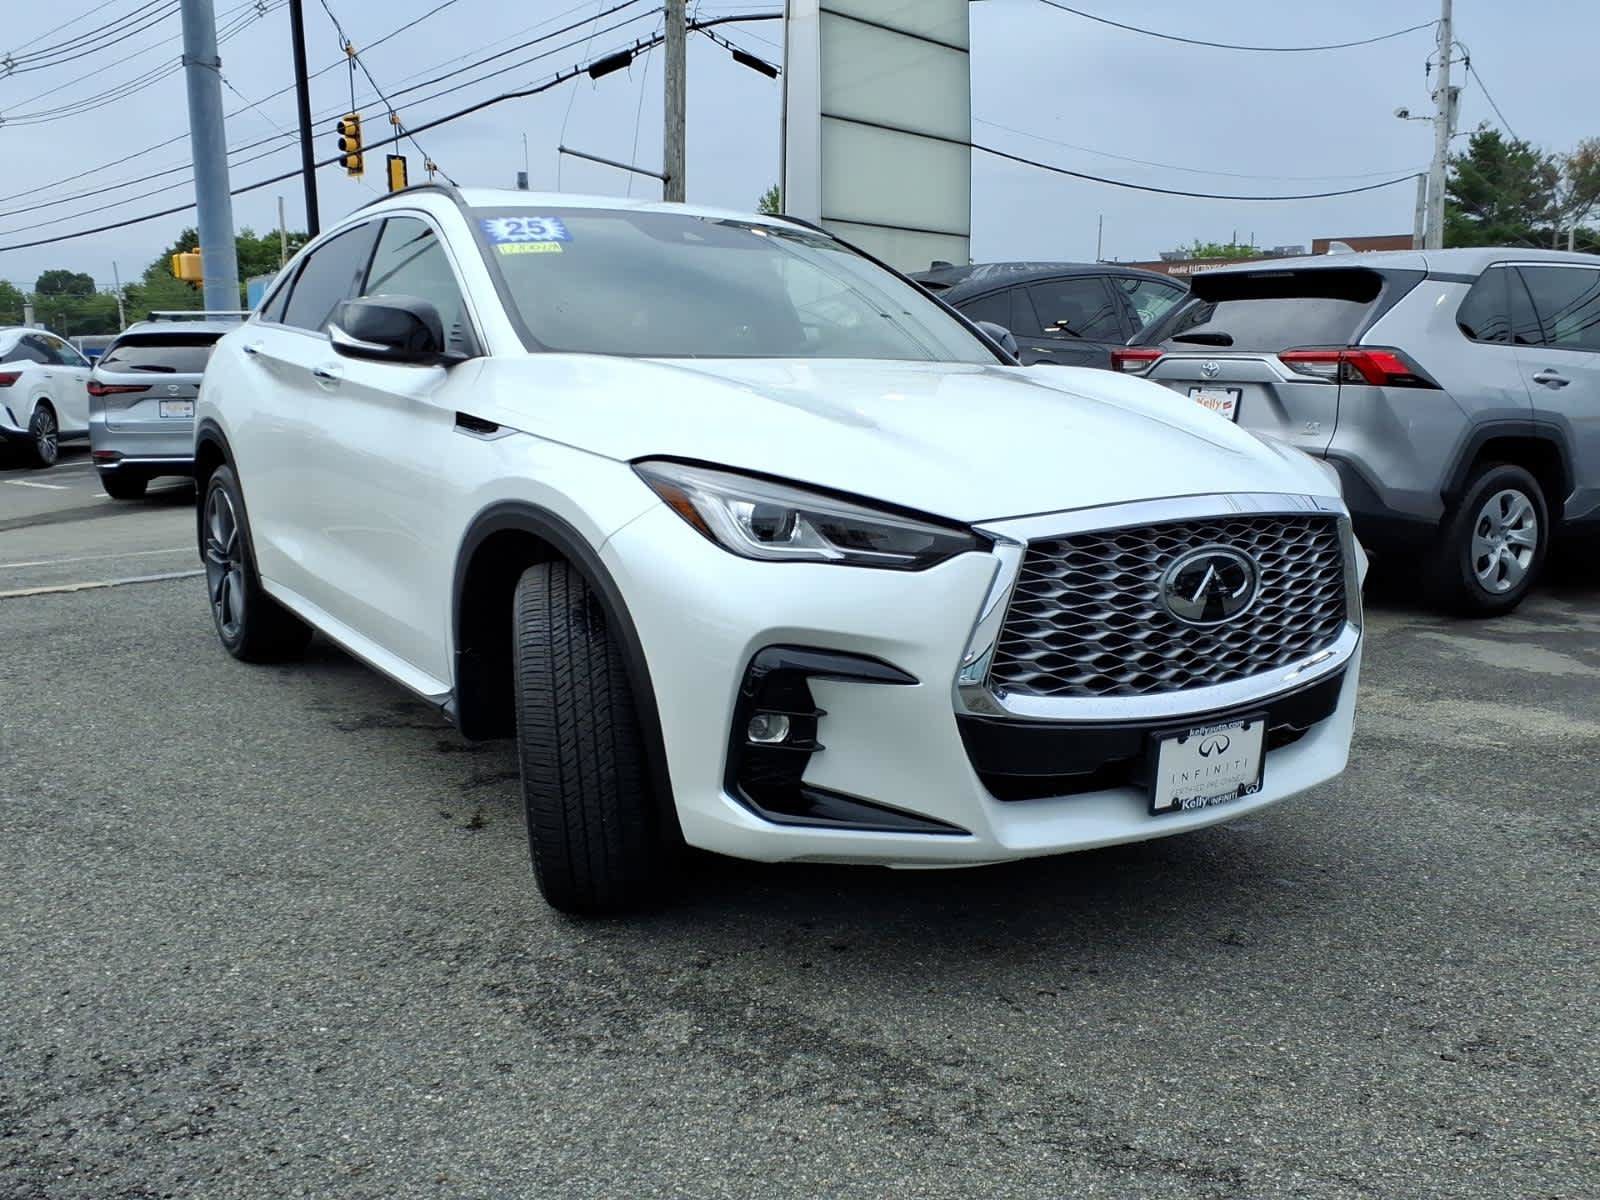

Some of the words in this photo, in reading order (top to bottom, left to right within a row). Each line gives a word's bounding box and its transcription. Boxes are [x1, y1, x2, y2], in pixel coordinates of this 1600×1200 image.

[505, 220, 547, 236] 25
[1172, 759, 1248, 783] INFINITI
[1182, 795, 1209, 810] Kelly
